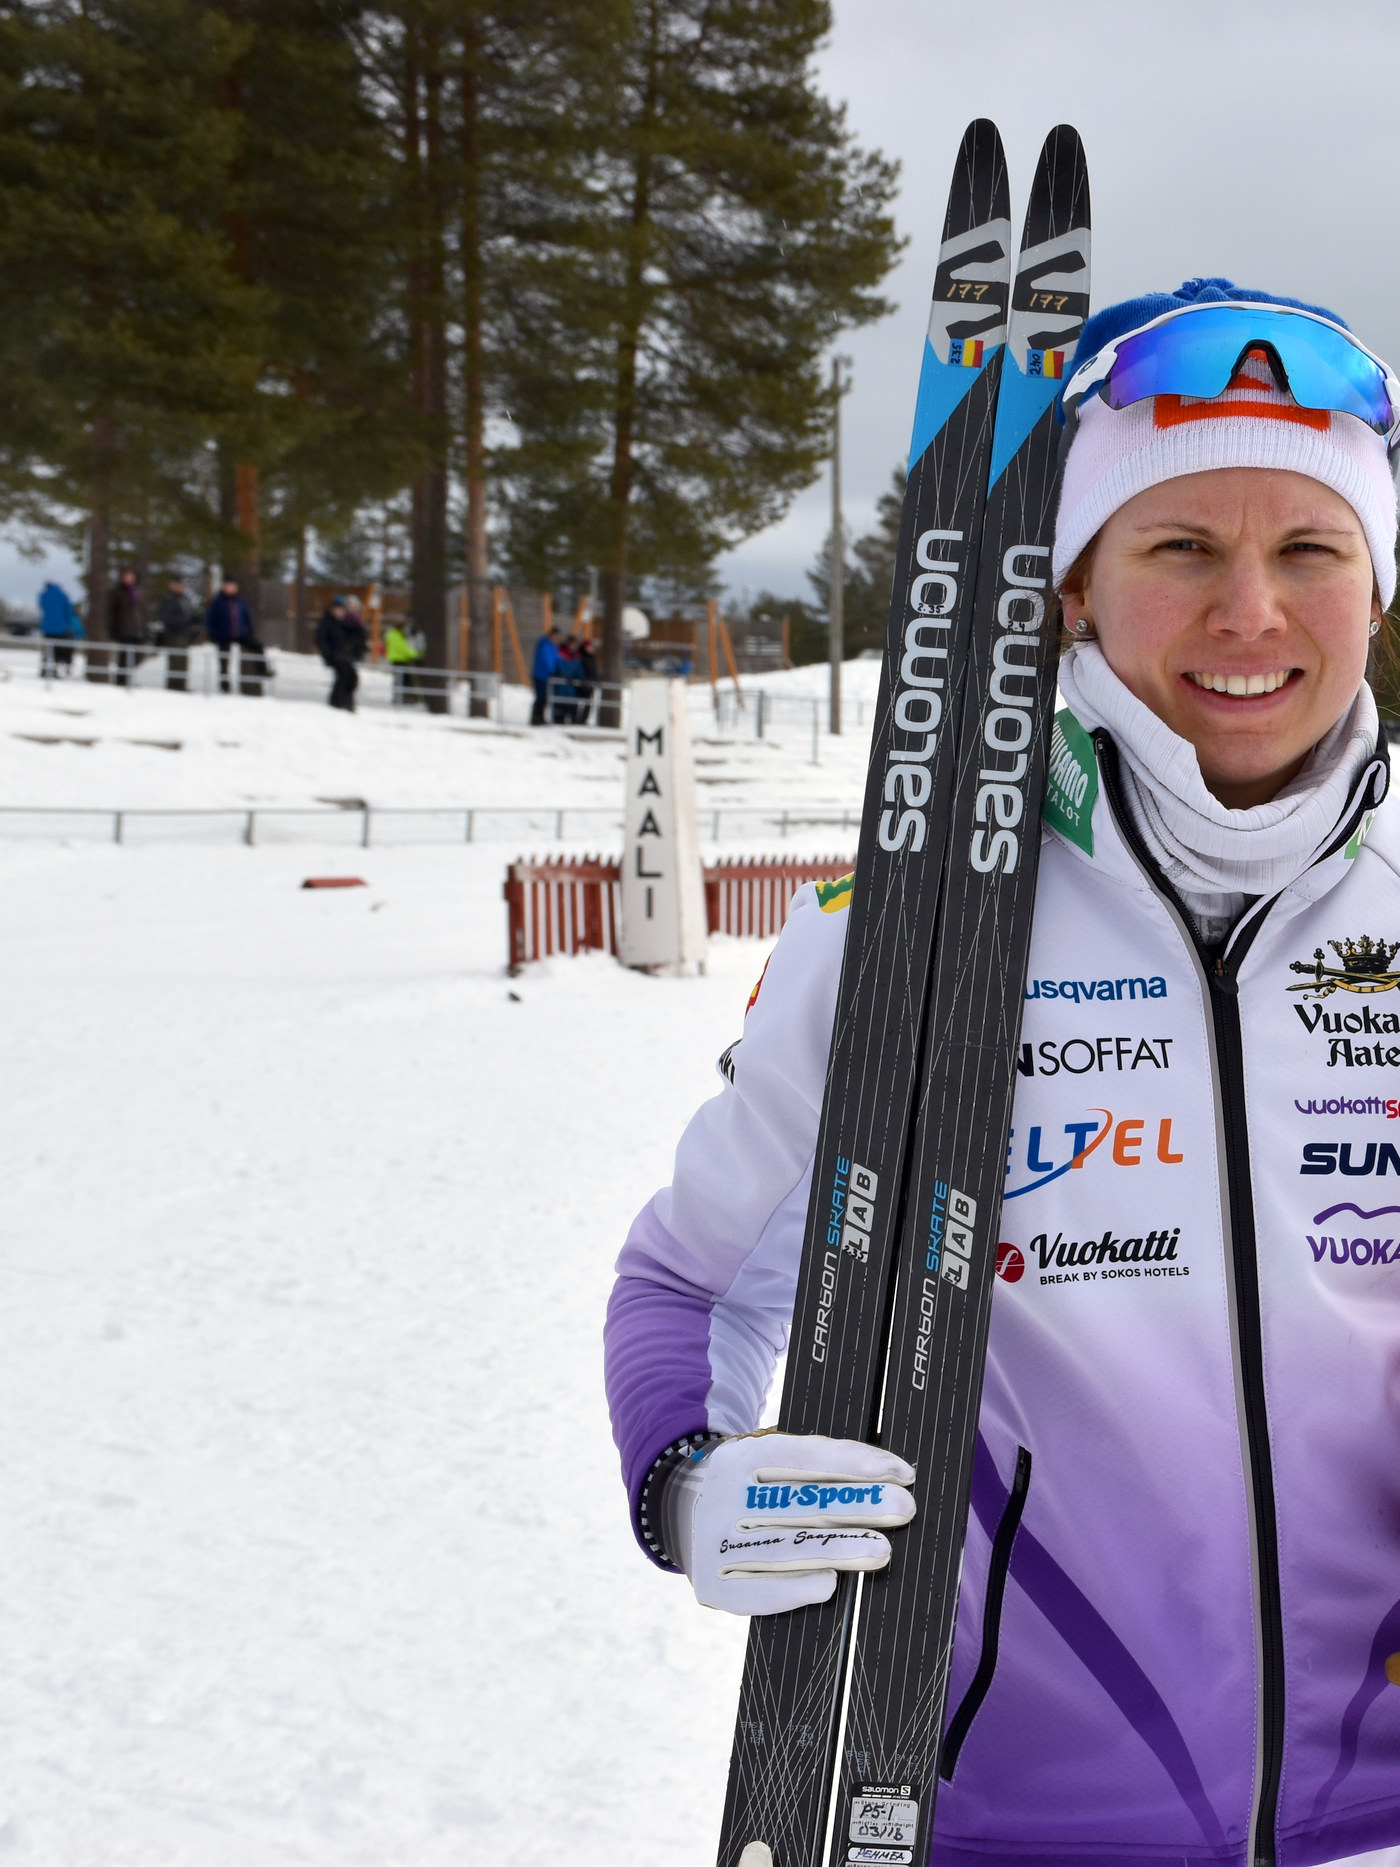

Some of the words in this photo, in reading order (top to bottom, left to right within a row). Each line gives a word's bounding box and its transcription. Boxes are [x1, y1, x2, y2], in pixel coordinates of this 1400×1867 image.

[946, 283, 989, 301] 177
[1029, 292, 1069, 311] 177
[878, 529, 964, 853] salomon
[970, 544, 1050, 874] salomon
[636, 727, 663, 920] MAALI
[1025, 976, 1168, 1004] usqvarna
[827, 1156, 850, 1247] SKATE
[926, 1180, 948, 1273] SKATE
[1029, 1227, 1181, 1269] Vuokatti
[1039, 1272, 1080, 1286] BREAK
[1083, 1270, 1098, 1281] BY
[1101, 1268, 1141, 1279] SOKOS
[1144, 1266, 1190, 1277] HOTELS
[719, 1538, 786, 1554] Susanna
[862, 1785, 899, 1794] salomon
